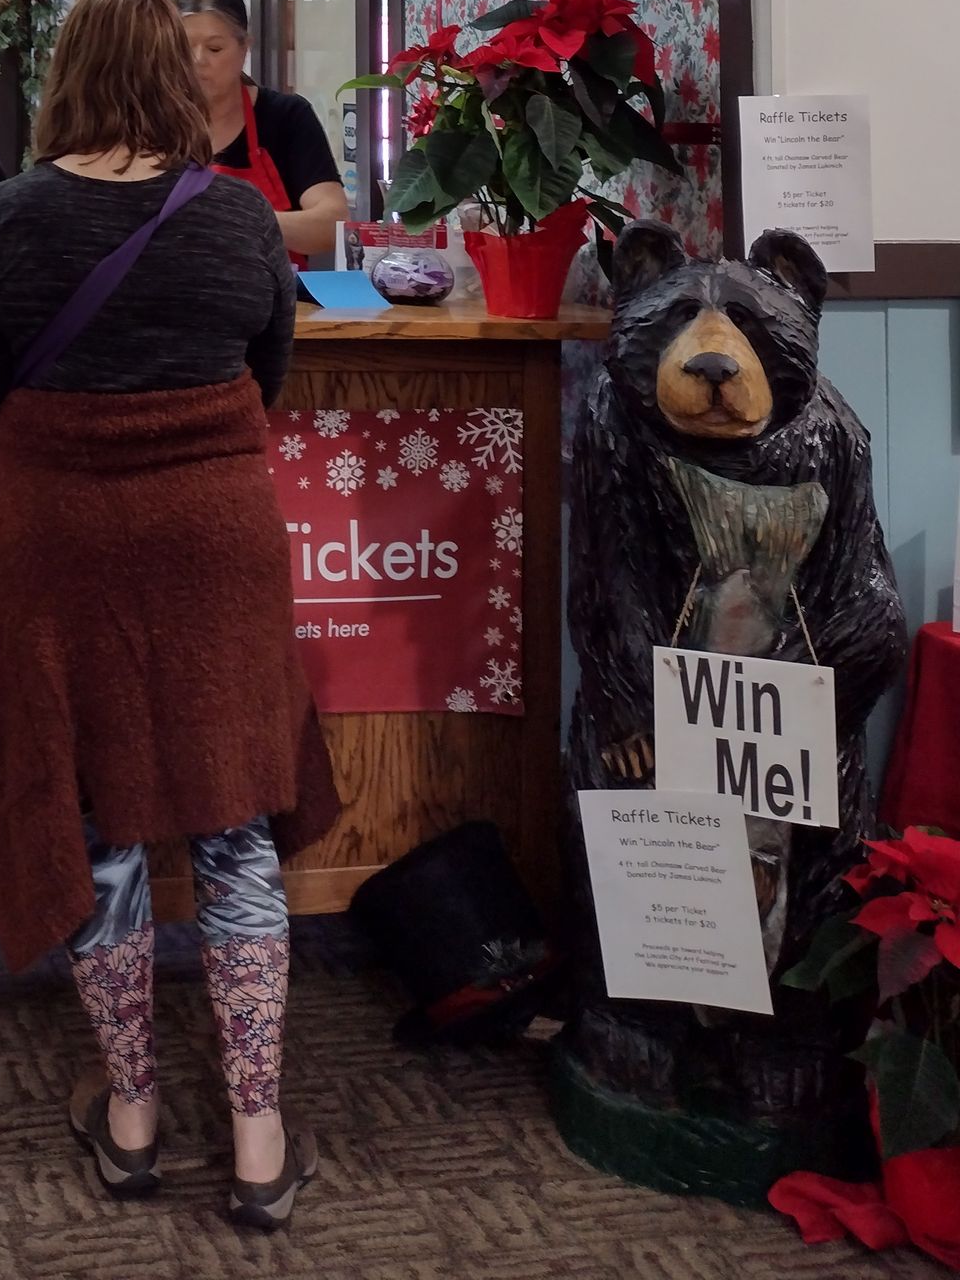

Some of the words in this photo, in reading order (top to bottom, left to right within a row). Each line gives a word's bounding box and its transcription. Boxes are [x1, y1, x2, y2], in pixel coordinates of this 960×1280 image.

[759, 111, 795, 124] Raffle
[798, 110, 848, 122] Tickets
[783, 191, 791, 199] $5
[820, 200, 834, 208] $20
[327, 618, 370, 638] here
[676, 654, 782, 736] Win
[715, 737, 812, 820] Me!
[611, 809, 660, 824] Raffle
[664, 810, 721, 828] Tickets
[618, 837, 638, 846] Win
[677, 840, 693, 849] the
[684, 863, 709, 872] Carved
[658, 871, 667, 879] by
[669, 872, 692, 881] James
[651, 903, 662, 912] $5
[665, 905, 679, 913] per
[681, 905, 707, 915] Ticket
[645, 915, 651, 923] 5
[653, 916, 681, 925] tickets
[684, 917, 697, 926] for
[700, 919, 717, 929] $20
